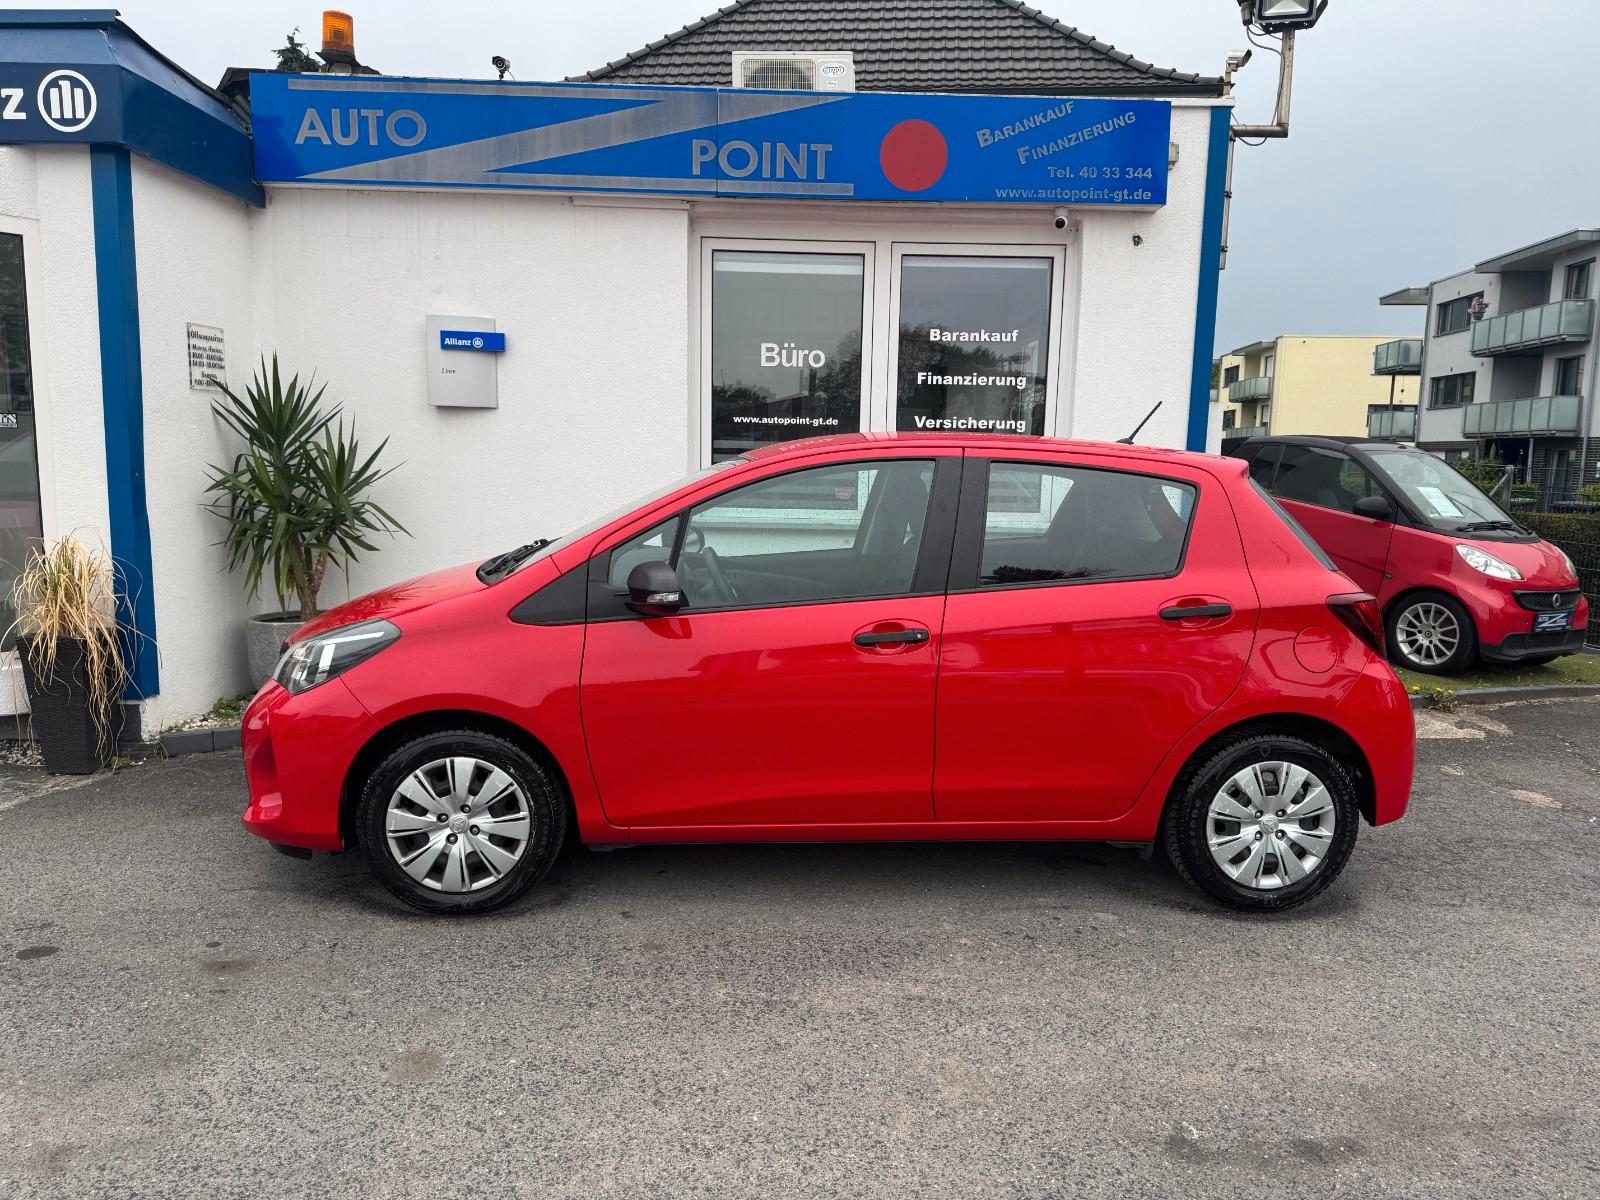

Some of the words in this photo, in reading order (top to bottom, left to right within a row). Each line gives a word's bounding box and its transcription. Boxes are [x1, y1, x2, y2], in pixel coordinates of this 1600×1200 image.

[295, 108, 426, 147] AUTO
[692, 139, 832, 179] POINT
[1048, 166, 1074, 178] Tel.
[1079, 166, 1098, 178] 40
[1102, 167, 1120, 178] 33
[1125, 167, 1152, 179] 344
[995, 187, 1151, 202] www.autopoint-gt.de
[444, 337, 472, 346] Allianz
[929, 328, 1019, 343] Barankauf
[760, 342, 826, 368] Büro
[917, 372, 1026, 389] Finanzierung
[733, 415, 839, 427] www.autopoint-gt.de
[914, 415, 1026, 433] Versicherung
